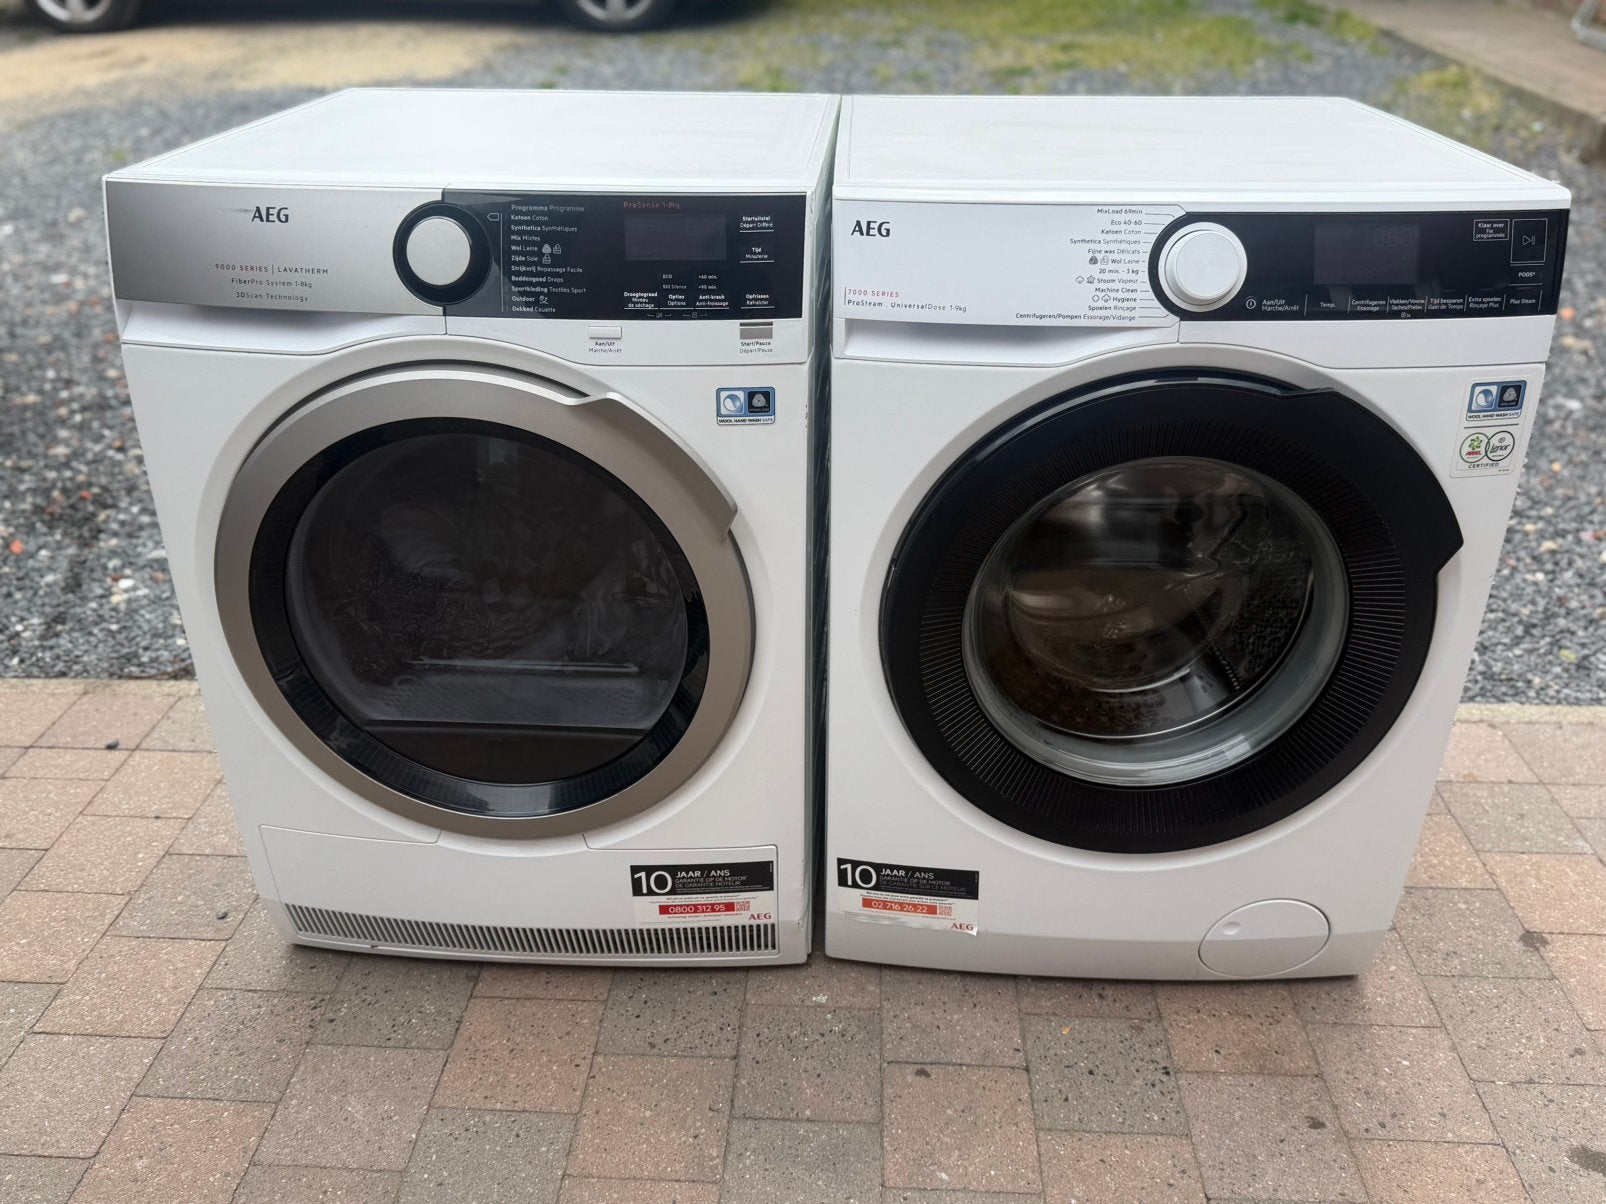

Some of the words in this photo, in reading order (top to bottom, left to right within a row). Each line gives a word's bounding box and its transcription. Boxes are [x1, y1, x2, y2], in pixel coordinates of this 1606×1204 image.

[511, 204, 548, 212] Programma
[251, 206, 289, 223] AEG
[850, 220, 891, 238] AEG
[240, 265, 268, 273] SERIES
[278, 266, 328, 275] LAVATHERM
[231, 278, 263, 286] FiberPro
[266, 279, 292, 287] System
[236, 291, 262, 299] 3DScan
[266, 293, 308, 302] Technology
[871, 290, 900, 298] SERIES
[847, 299, 883, 307] ProSteam
[890, 302, 946, 310] UniversalDose
[676, 870, 701, 878] JAAR
[840, 863, 878, 888] 10
[880, 868, 906, 876] JAAR
[914, 872, 935, 880] ANS
[634, 870, 673, 894] 10
[668, 906, 694, 914] 0800
[696, 905, 712, 913] 312
[872, 900, 884, 908] 02
[886, 902, 901, 910] 716
[903, 904, 915, 912] 26
[916, 905, 928, 913] 22
[748, 912, 772, 921] AEG
[950, 922, 974, 931] AEG
